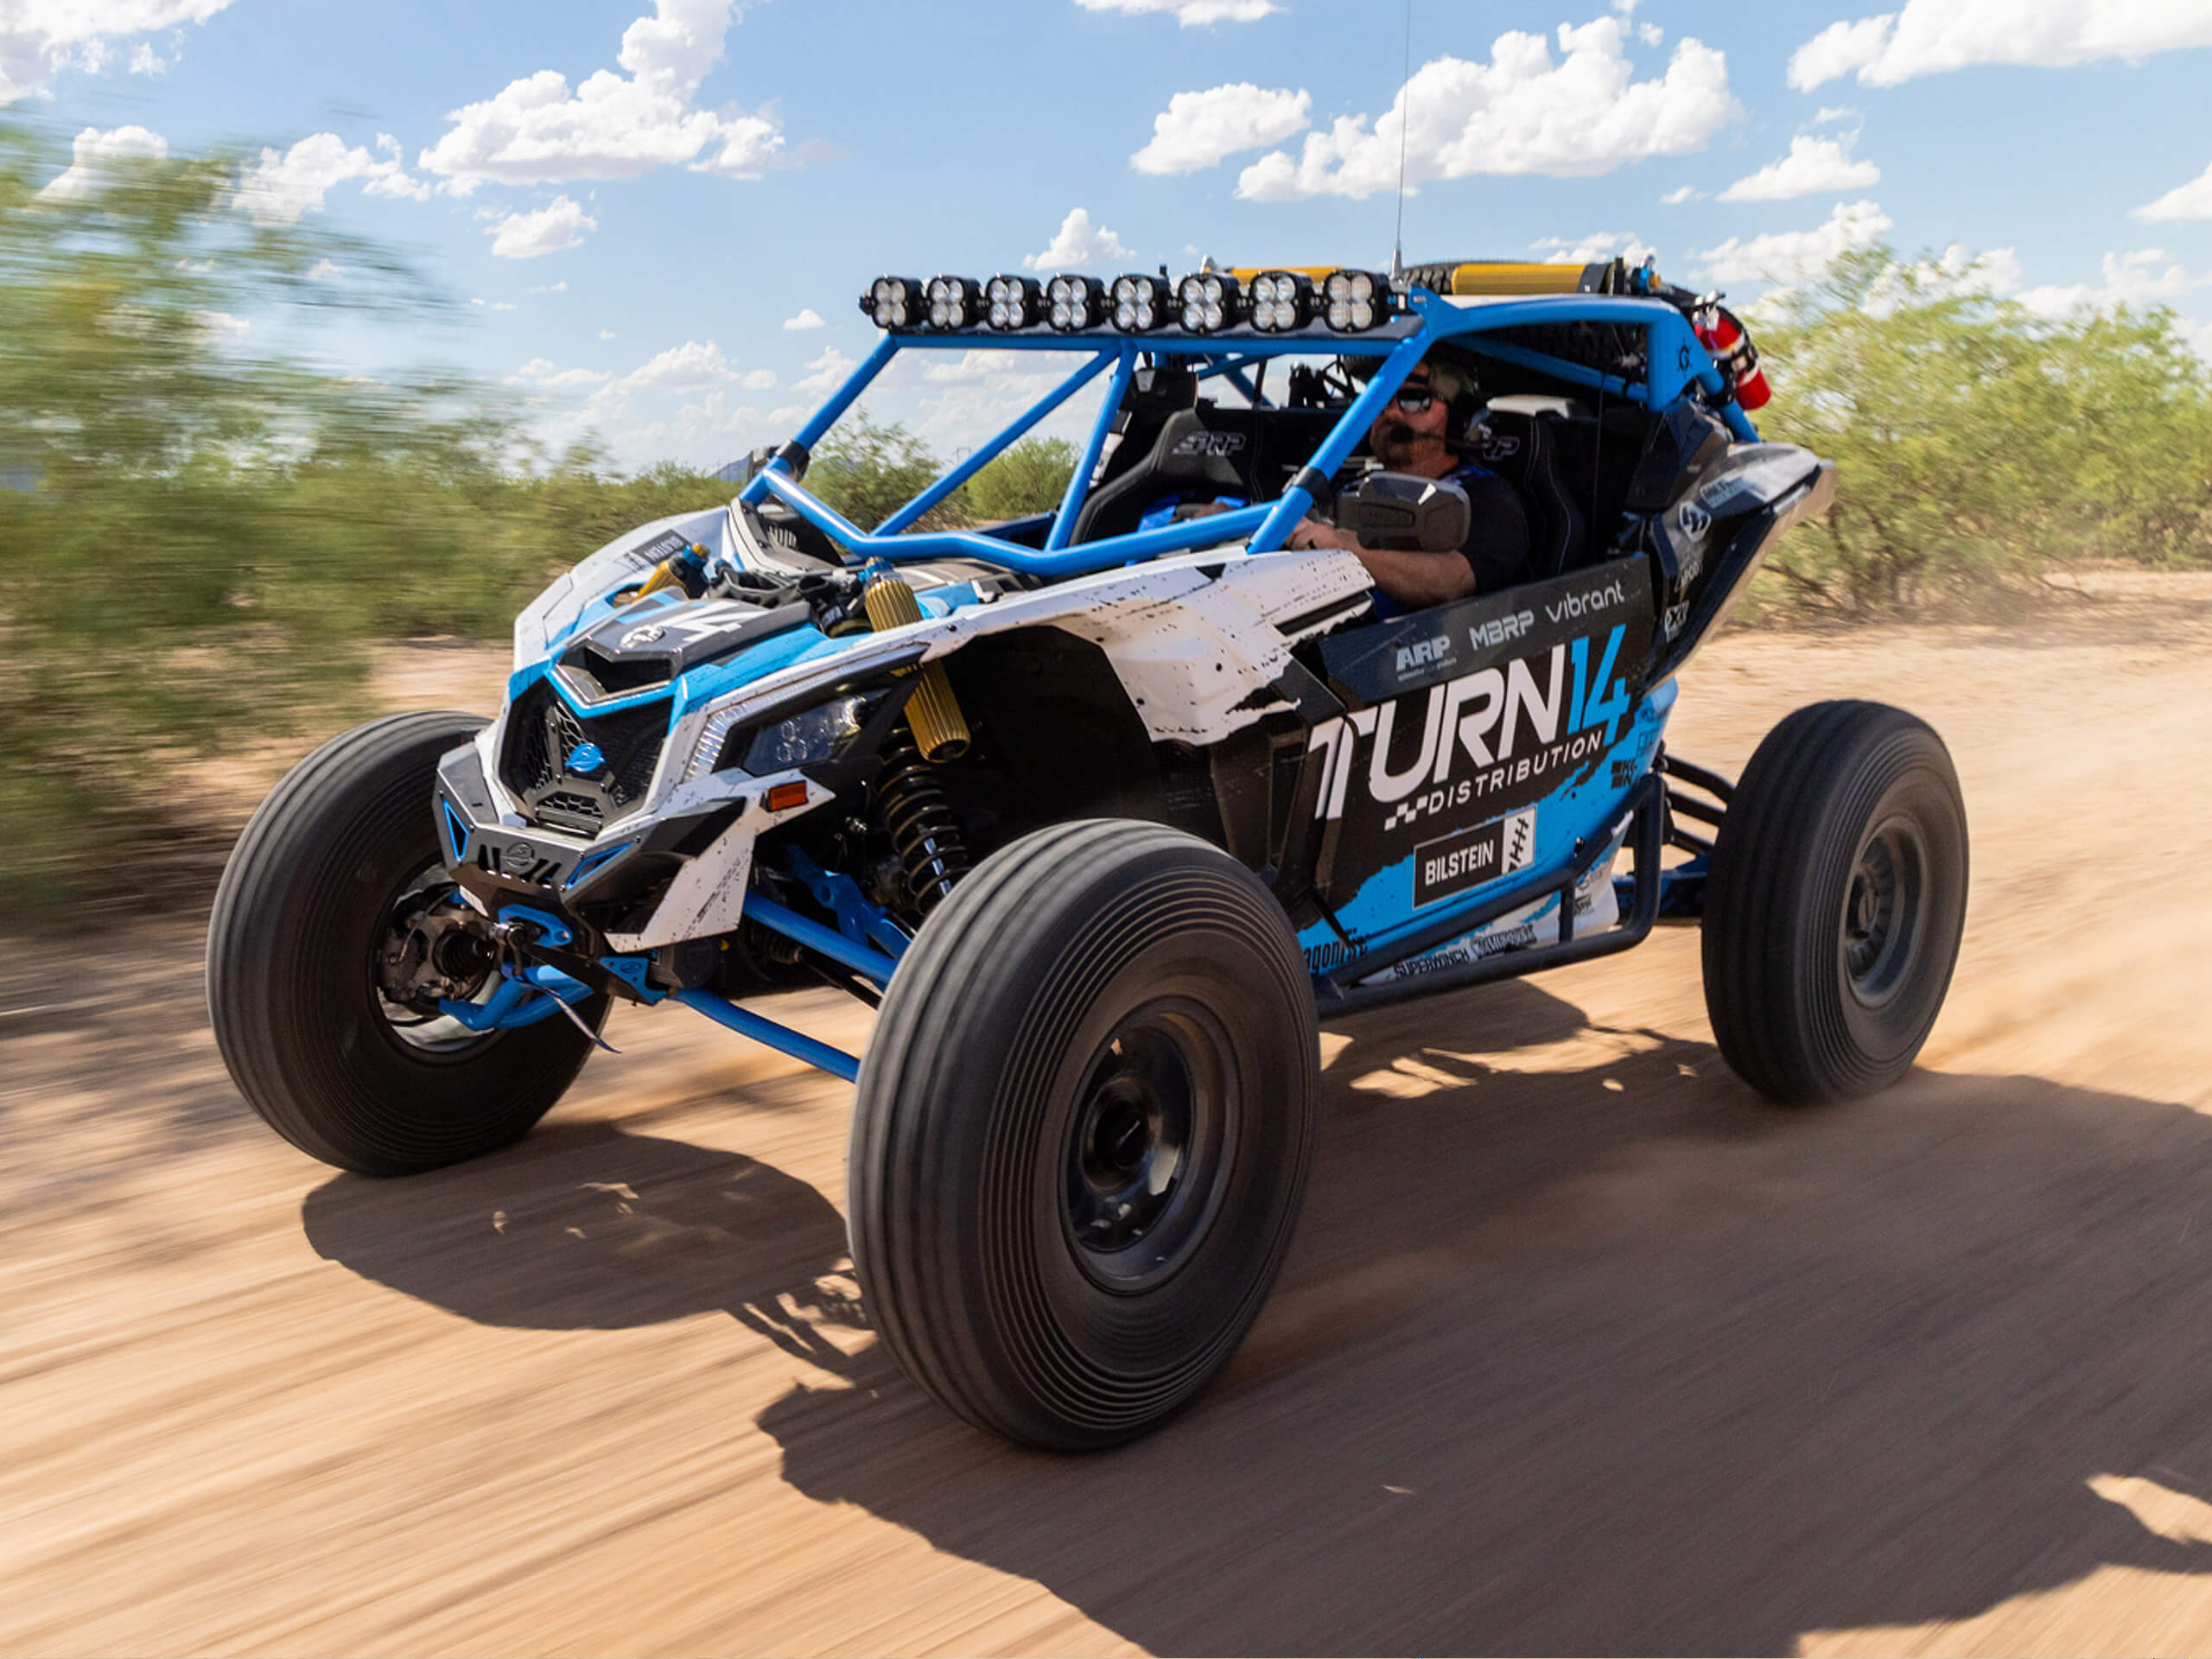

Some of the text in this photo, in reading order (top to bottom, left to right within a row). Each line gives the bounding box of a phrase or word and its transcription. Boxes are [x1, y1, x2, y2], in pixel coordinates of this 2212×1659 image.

[1395, 634, 1451, 672] ARP
[1469, 610, 1535, 652] MBRP
[1427, 730, 1602, 815] DISTRIBUTION
[1424, 838, 1495, 887] BILSTEIN
